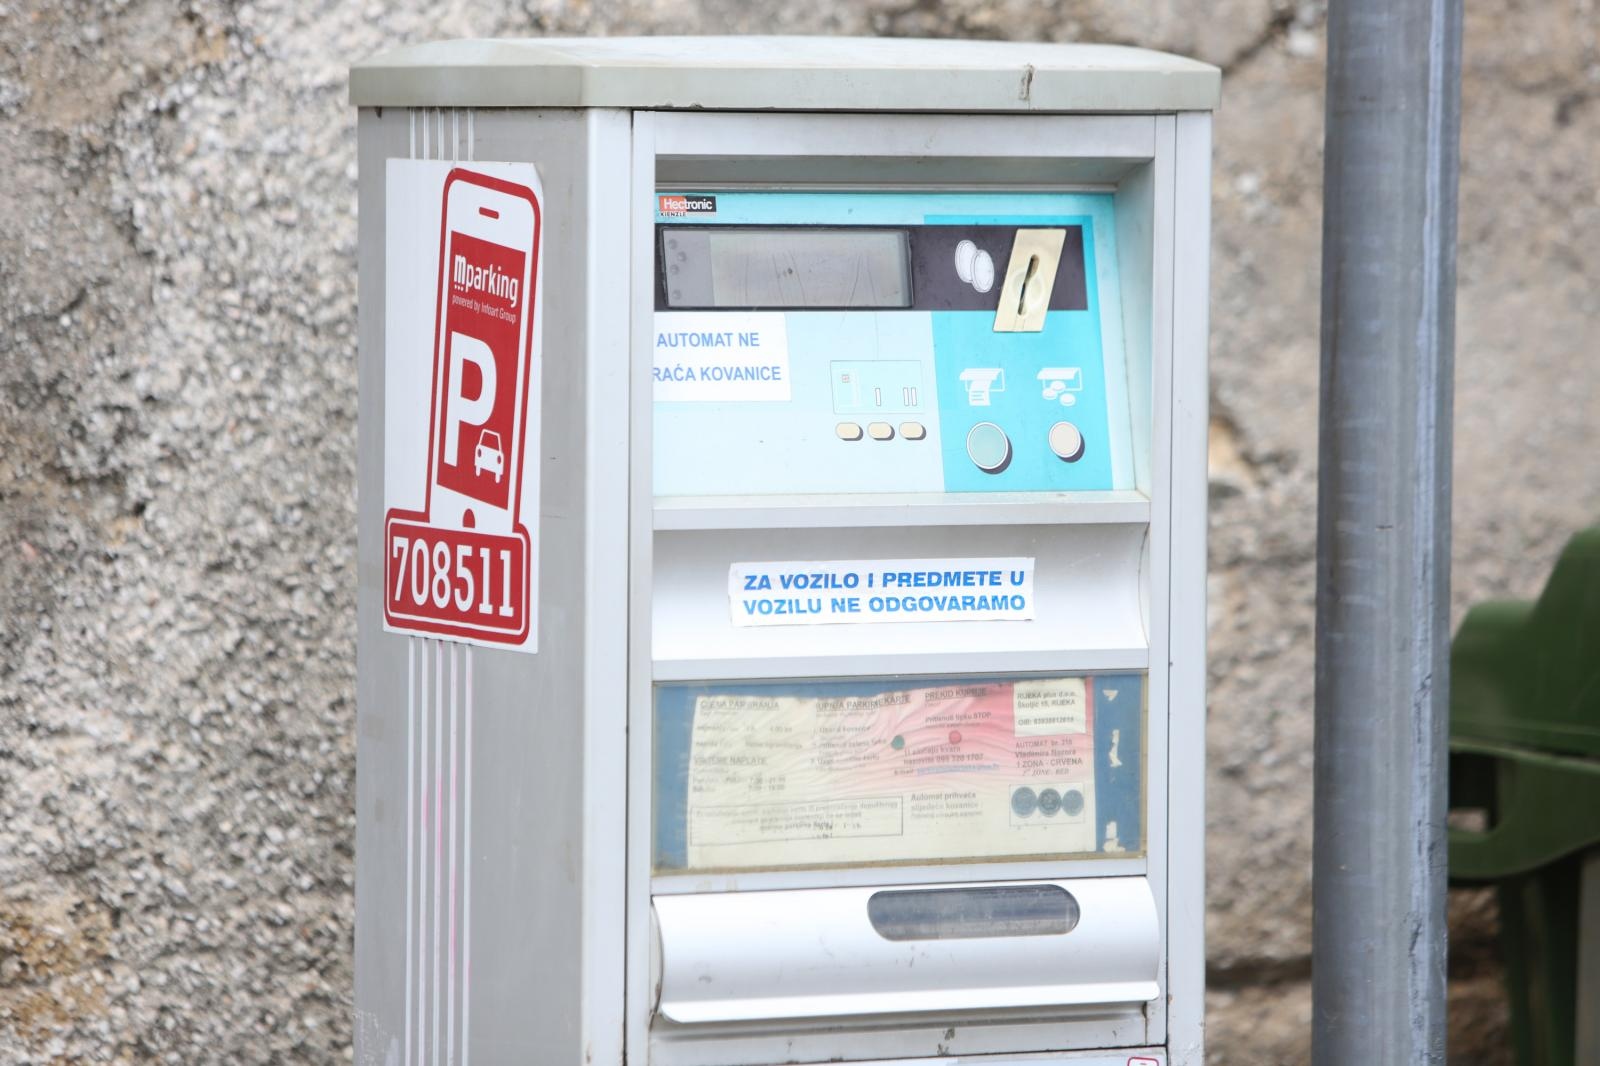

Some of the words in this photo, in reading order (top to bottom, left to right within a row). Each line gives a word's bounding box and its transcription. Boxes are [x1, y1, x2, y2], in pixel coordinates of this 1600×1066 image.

[663, 198, 713, 211] Hectronic
[453, 254, 519, 308] mparking
[452, 294, 473, 310] powered
[473, 301, 481, 314] by
[499, 307, 517, 325] Group
[656, 332, 734, 347] AUTOMAT
[738, 332, 761, 347] NE
[700, 366, 782, 381] KOVANICE
[444, 331, 497, 467] P
[393, 536, 514, 617] 708511
[743, 574, 772, 590] ZA
[779, 572, 860, 590] VOZILO
[867, 572, 874, 588] I
[882, 570, 1003, 588] PREDMETE
[1010, 570, 1025, 586] U
[743, 598, 822, 615] VOZILU
[830, 597, 861, 613] NE
[868, 594, 1026, 612] ODGOVARAMO
[1022, 759, 1044, 768] ZONA
[1050, 757, 1084, 767] CRVENA
